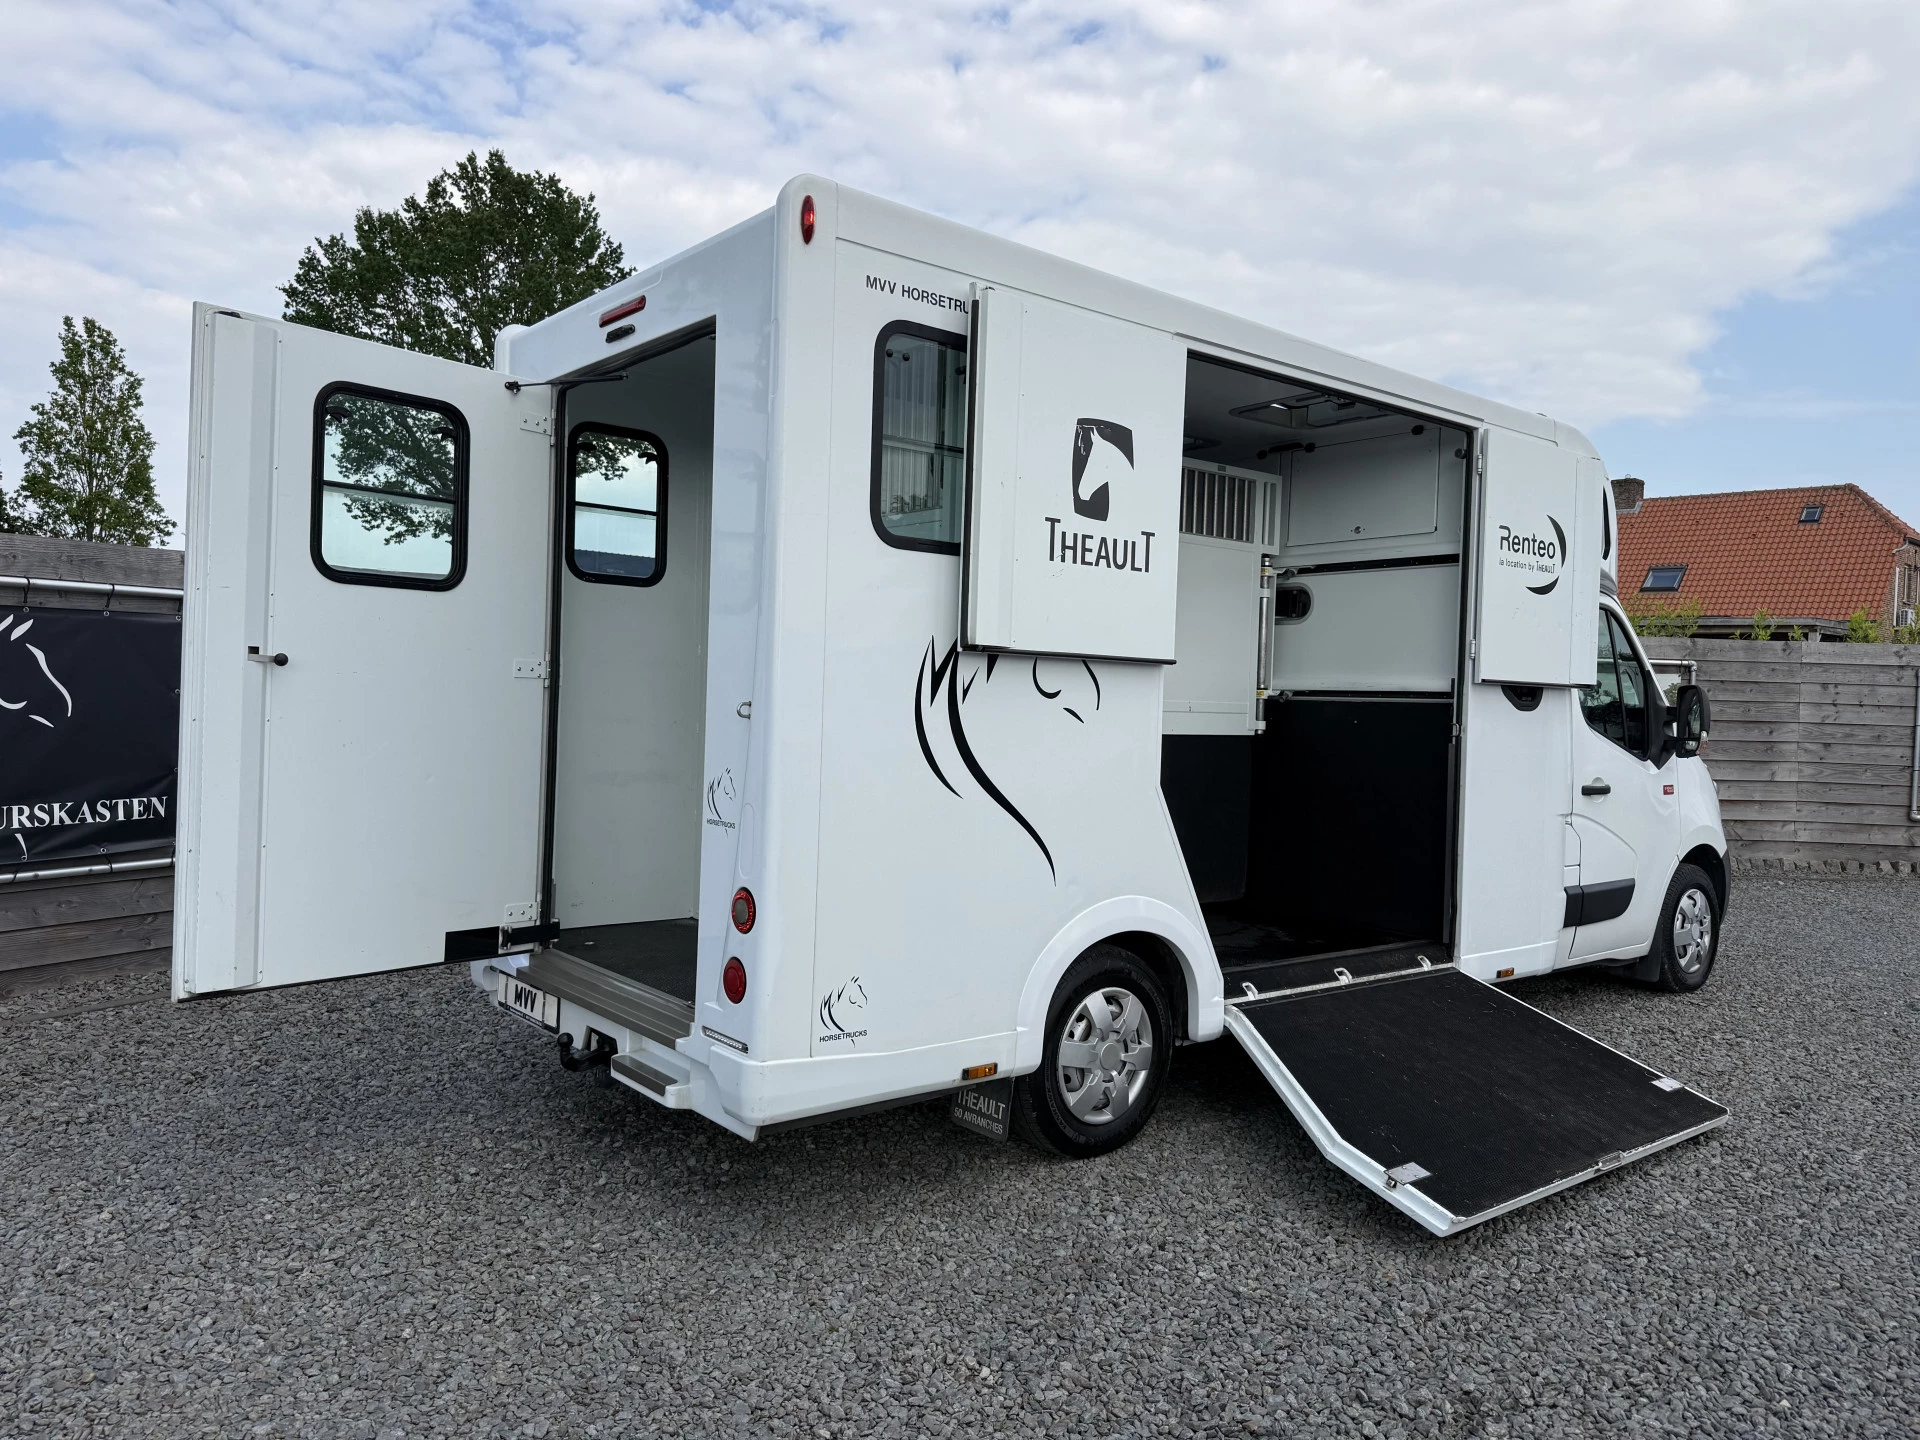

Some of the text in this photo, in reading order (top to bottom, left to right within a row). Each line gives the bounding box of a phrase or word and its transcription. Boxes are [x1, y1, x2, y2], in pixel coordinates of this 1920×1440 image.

[866, 274, 897, 295] MVV
[1044, 516, 1156, 573] THEAULT
[1498, 524, 1556, 560] Renteo
[1505, 557, 1527, 570] location
[1527, 561, 1535, 573] by
[706, 818, 736, 830] HORSETRUCKS
[513, 983, 538, 1013] MVV
[819, 1029, 868, 1043] HORSETRUCKS
[953, 1107, 1003, 1135] 50 AVRANCHES
